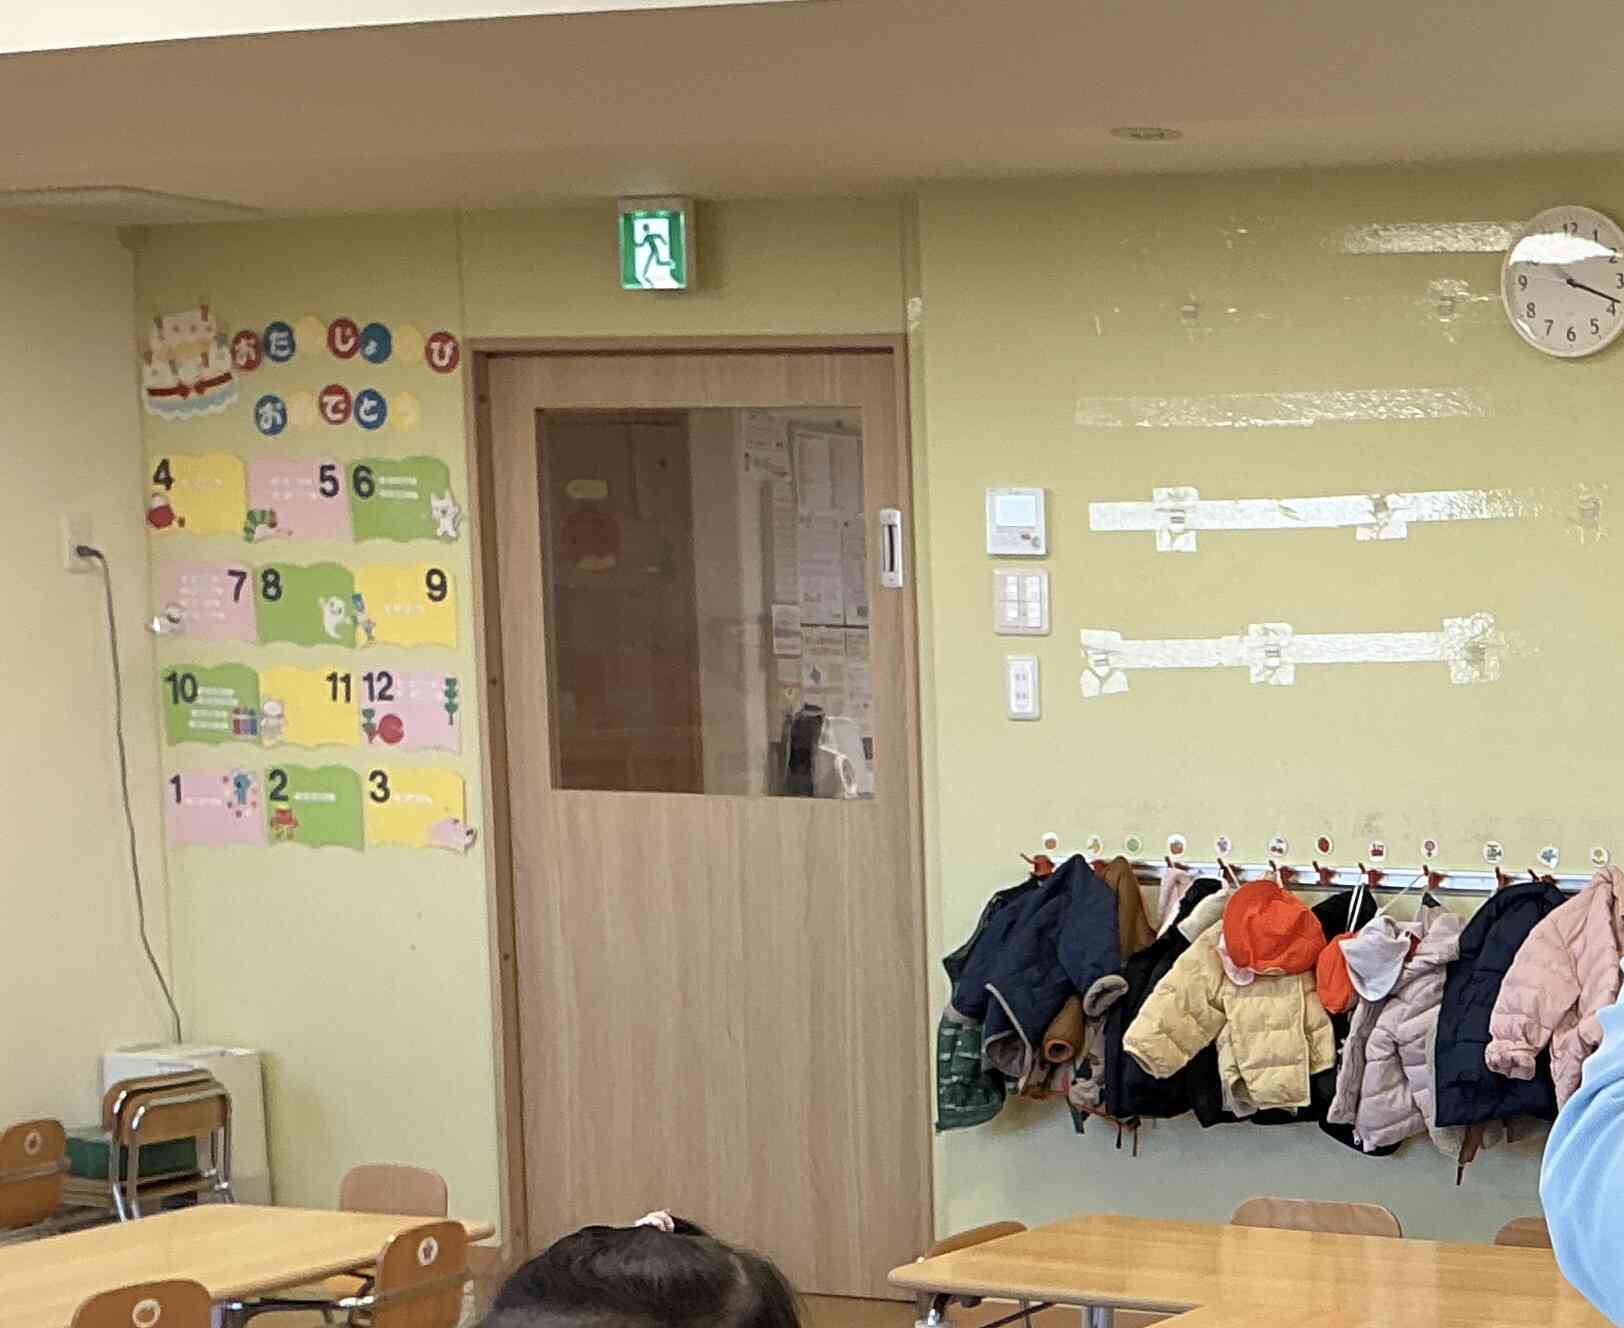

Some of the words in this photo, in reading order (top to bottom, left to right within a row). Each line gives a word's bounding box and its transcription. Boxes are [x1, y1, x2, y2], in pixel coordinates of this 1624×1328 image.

[1518, 275, 1528, 291] 9
[1615, 273, 1624, 289] 3
[1526, 302, 1536, 318] 8
[1606, 300, 1617, 316] 4
[1544, 319, 1554, 336] 7
[1566, 326, 1577, 342] 6
[1590, 318, 1600, 335] 5
[234, 322, 457, 371] おたじょび
[257, 391, 418, 432] おでとう
[152, 459, 175, 491] 4
[319, 464, 340, 498] 5
[352, 465, 375, 499] 6
[228, 569, 247, 603] 7
[261, 568, 282, 602] 8
[425, 568, 448, 602] 9
[164, 671, 199, 705] 10
[326, 672, 351, 704] 11
[363, 671, 395, 702] 12
[169, 774, 182, 804] 1
[269, 768, 289, 802] 2
[368, 769, 391, 804] 3
